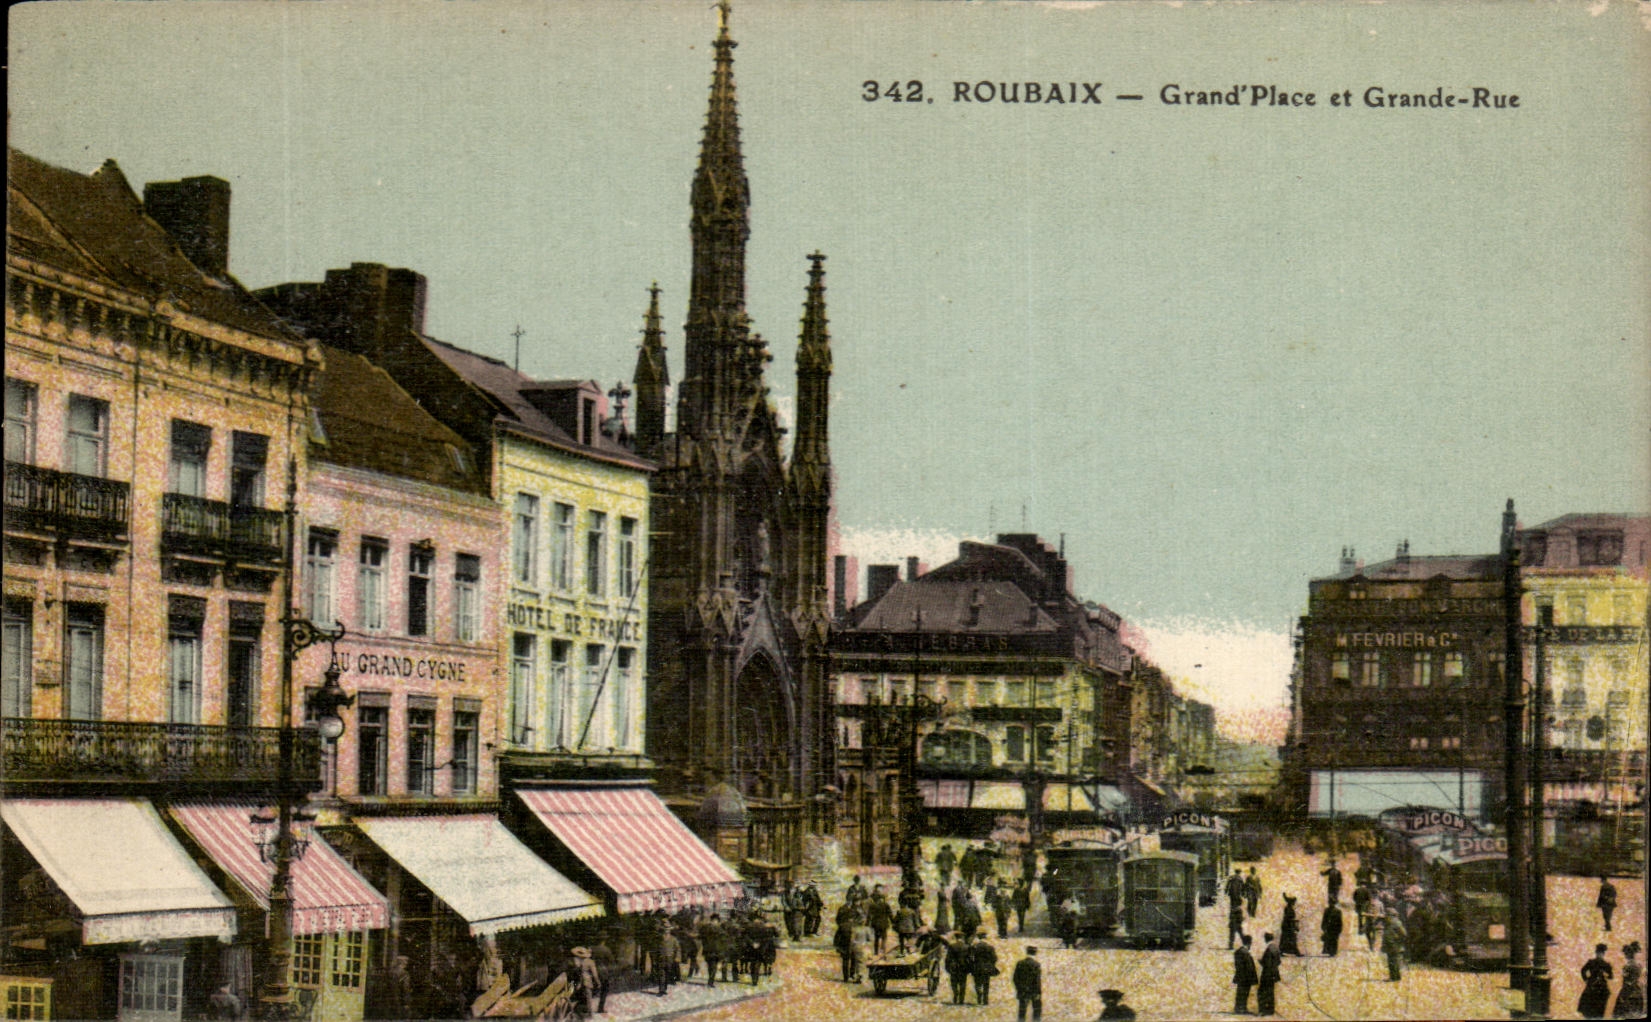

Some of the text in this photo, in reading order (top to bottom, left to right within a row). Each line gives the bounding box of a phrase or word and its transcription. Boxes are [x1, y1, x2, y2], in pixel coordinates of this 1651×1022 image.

[564, 612, 582, 637] DE
[590, 616, 641, 642] FRANCE
[330, 651, 466, 682] AU GRAND CYGNE
[1163, 812, 1210, 828] PICON
[1414, 812, 1465, 829] PICON
[1458, 838, 1508, 852] PICO
